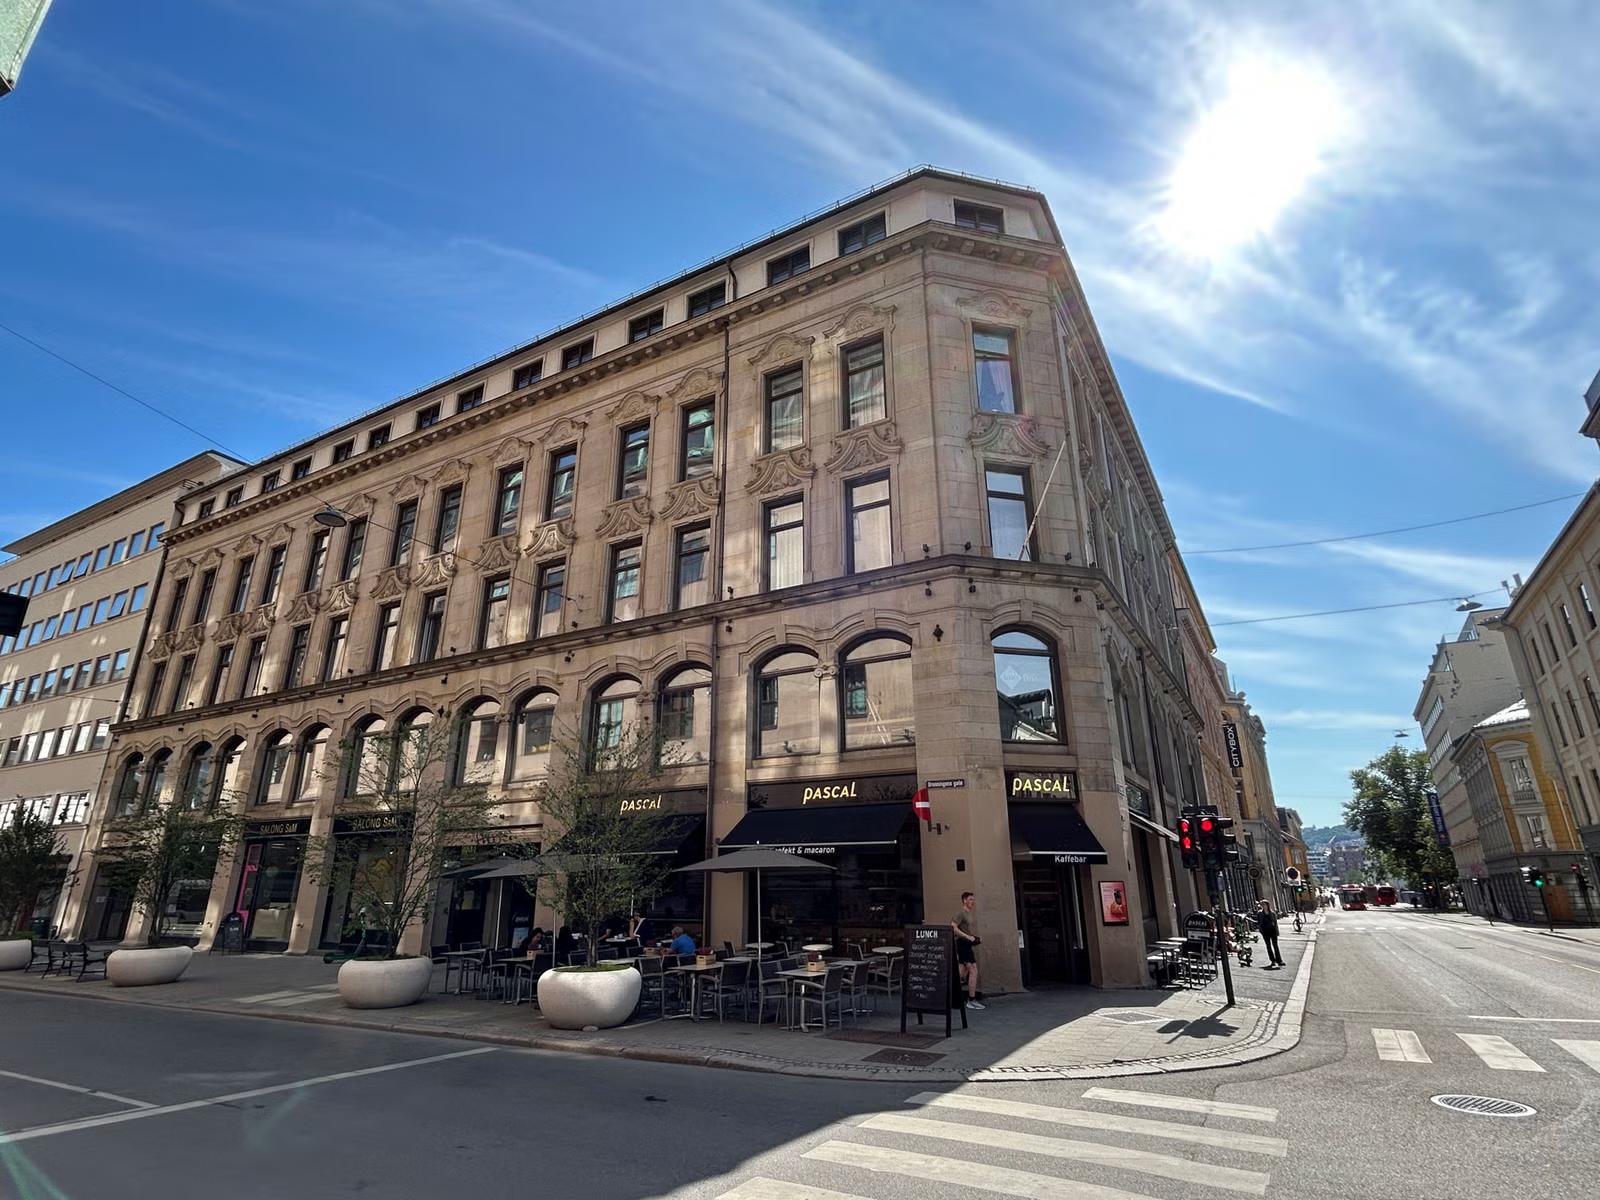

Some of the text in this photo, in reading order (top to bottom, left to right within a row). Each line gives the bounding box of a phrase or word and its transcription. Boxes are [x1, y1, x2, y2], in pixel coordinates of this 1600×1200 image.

[1226, 726, 1240, 767] CITYBOX
[1012, 776, 1070, 796] PASCAL
[802, 781, 857, 805] PASCAL
[260, 824, 284, 834] SALONG
[796, 846, 803, 854] &
[1054, 855, 1087, 863] Kaffebar
[915, 929, 939, 939] LUNCH
